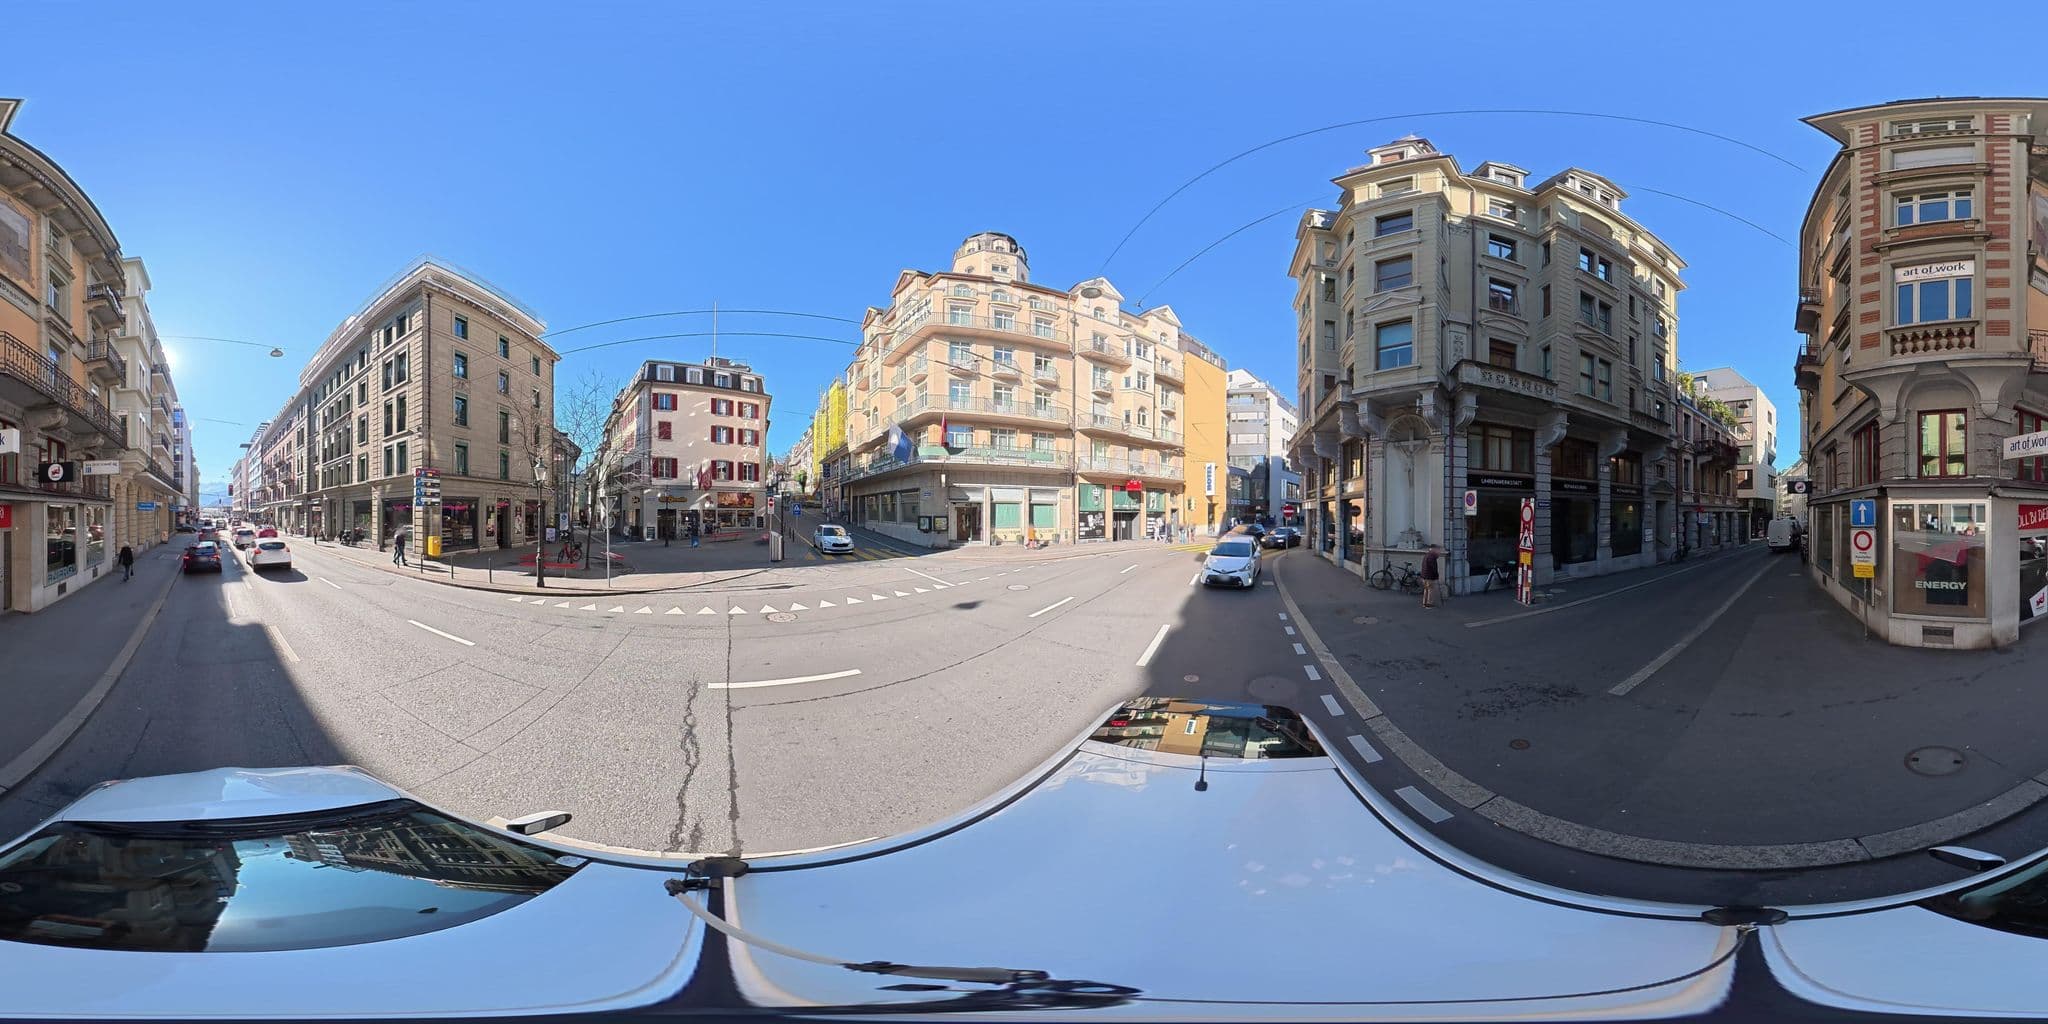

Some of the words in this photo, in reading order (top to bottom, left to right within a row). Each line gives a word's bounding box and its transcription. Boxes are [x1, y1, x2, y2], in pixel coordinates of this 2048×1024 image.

[1903, 267, 1919, 276] art
[1936, 262, 1966, 272] work
[2010, 439, 2021, 452] art
[1915, 580, 1967, 590] ENERGY
